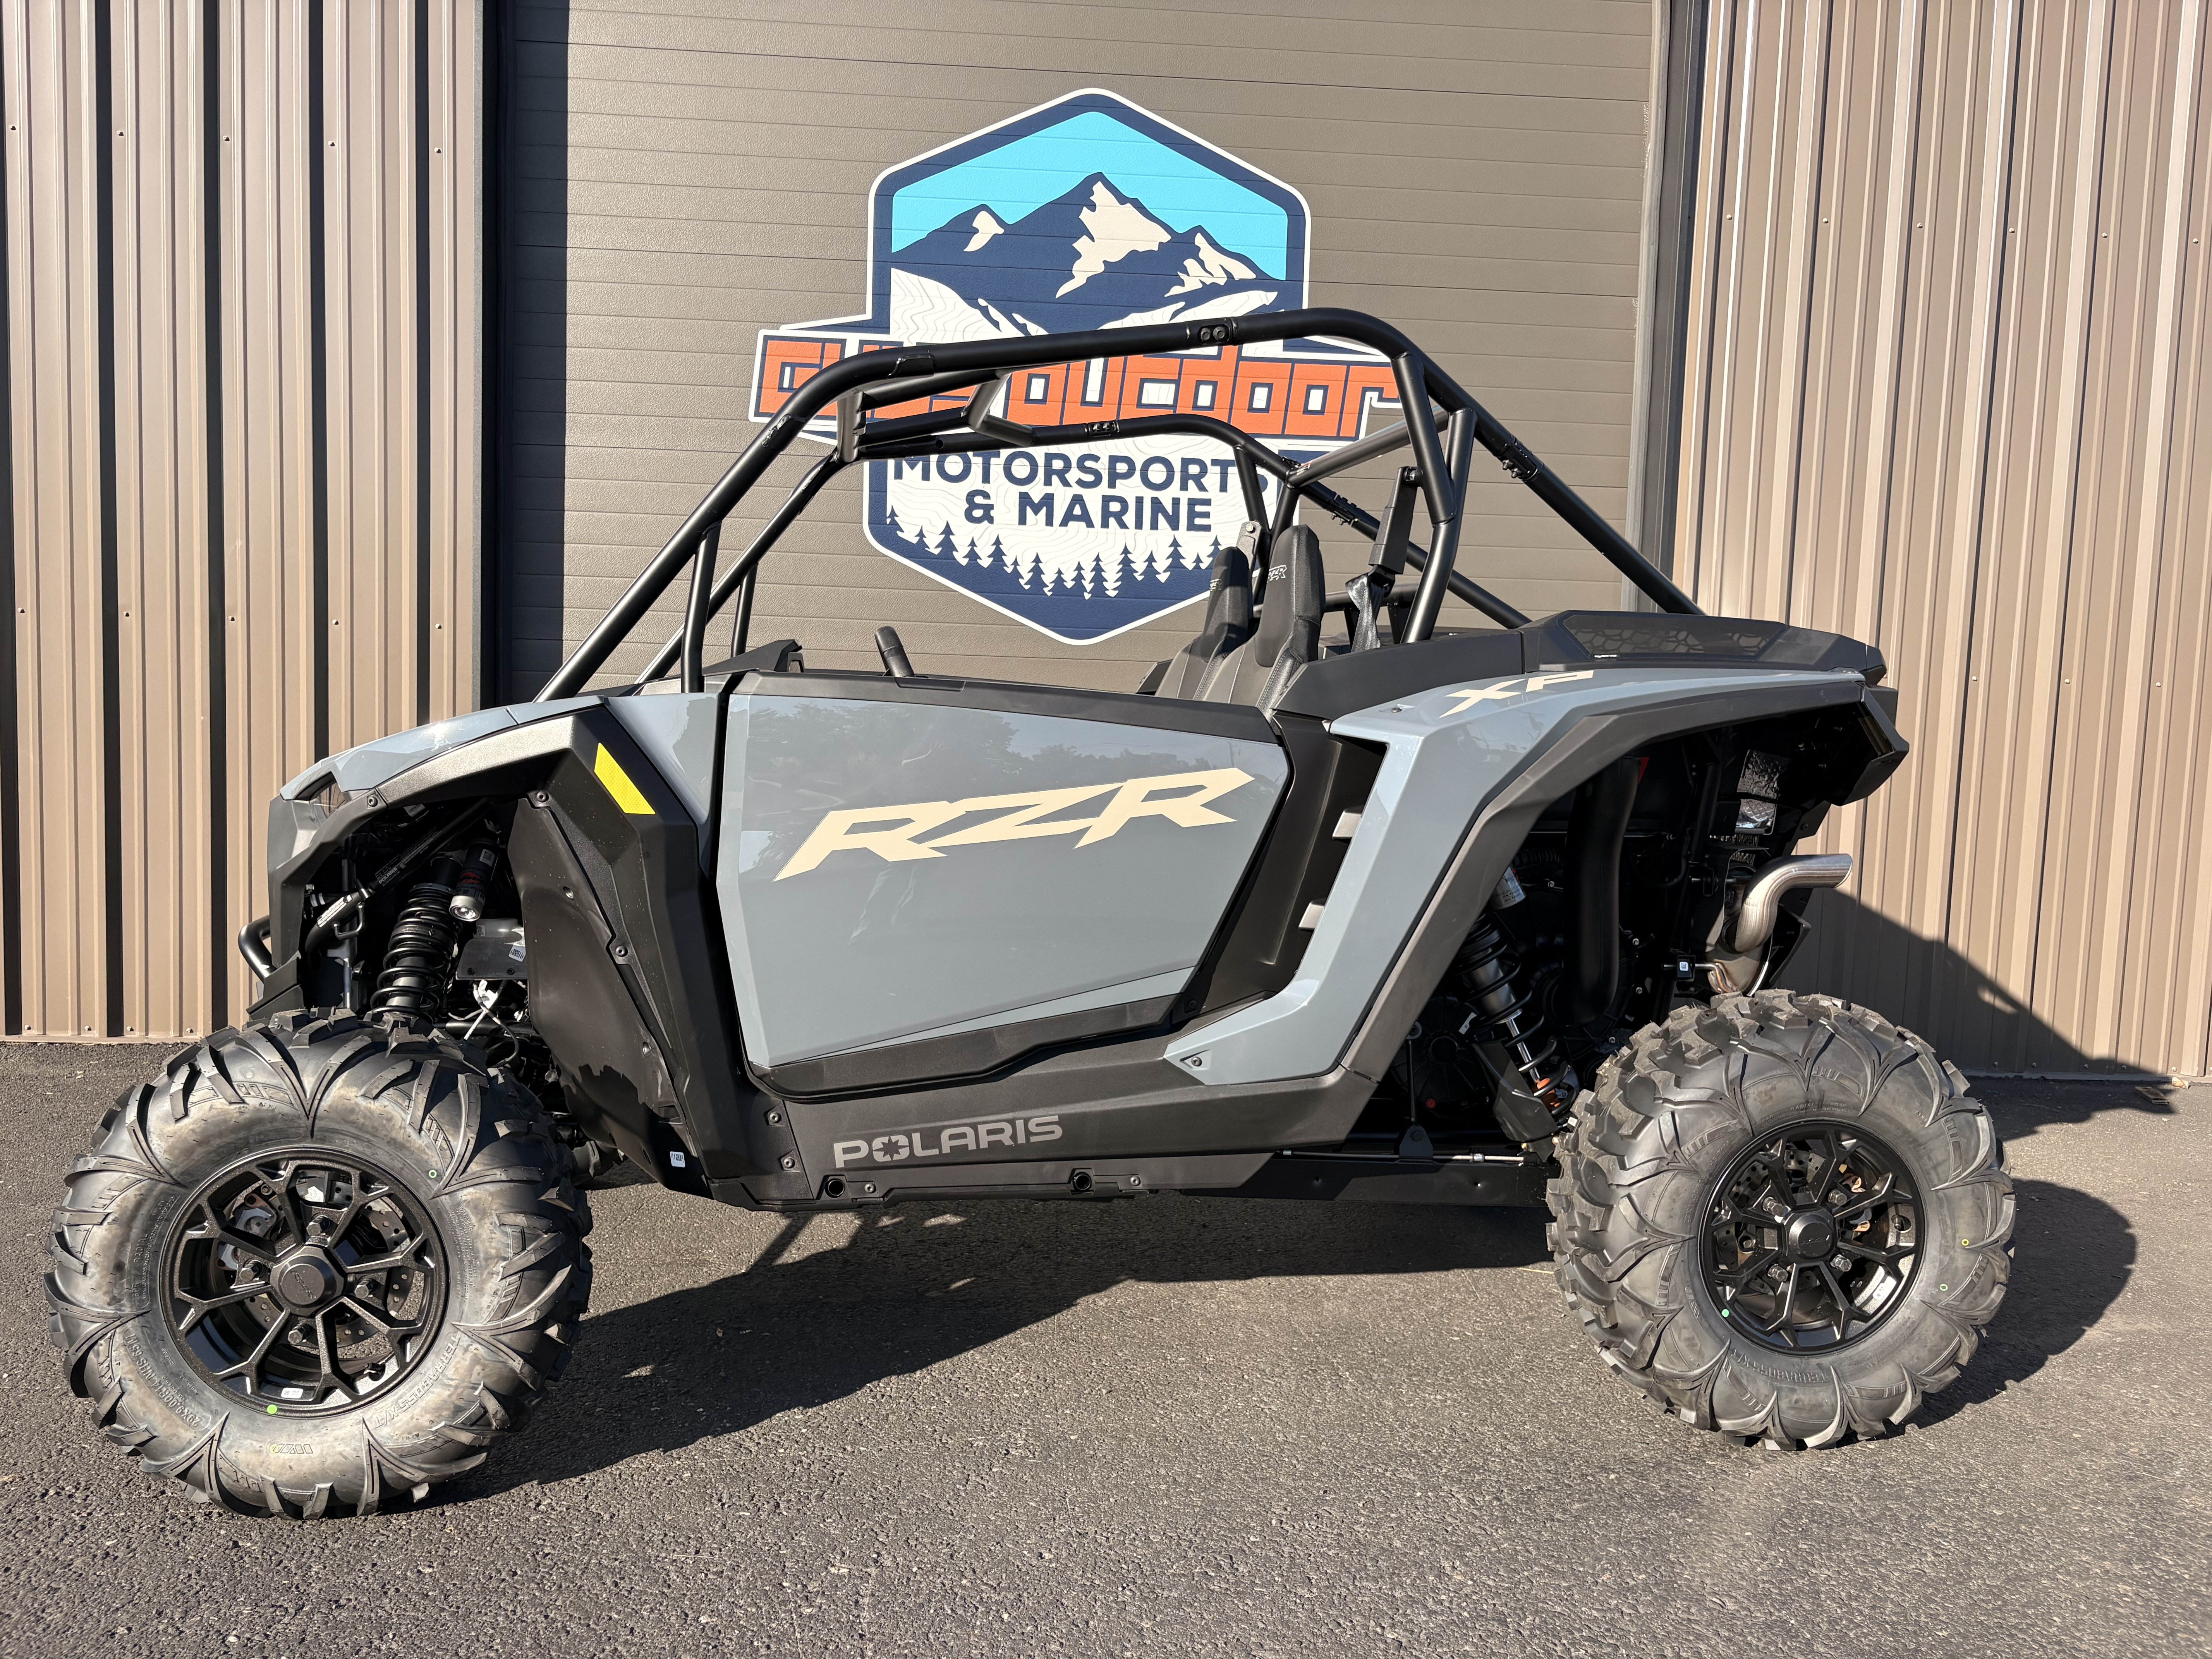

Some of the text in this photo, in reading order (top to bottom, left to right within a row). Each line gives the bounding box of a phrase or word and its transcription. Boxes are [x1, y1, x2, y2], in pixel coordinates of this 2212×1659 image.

[965, 489, 1212, 533] & MARINE
[1439, 670, 1594, 718] XP
[772, 767, 1255, 883] RZR
[378, 867, 398, 884] POLARIS
[833, 1115, 1063, 1168] POLARIS
[126, 1333, 143, 1358] 65M
[136, 1358, 156, 1380] NHS
[398, 1334, 461, 1412] TERRABOSS
[150, 1379, 202, 1429] 29X9.00R14
[374, 1406, 400, 1429] X/T
